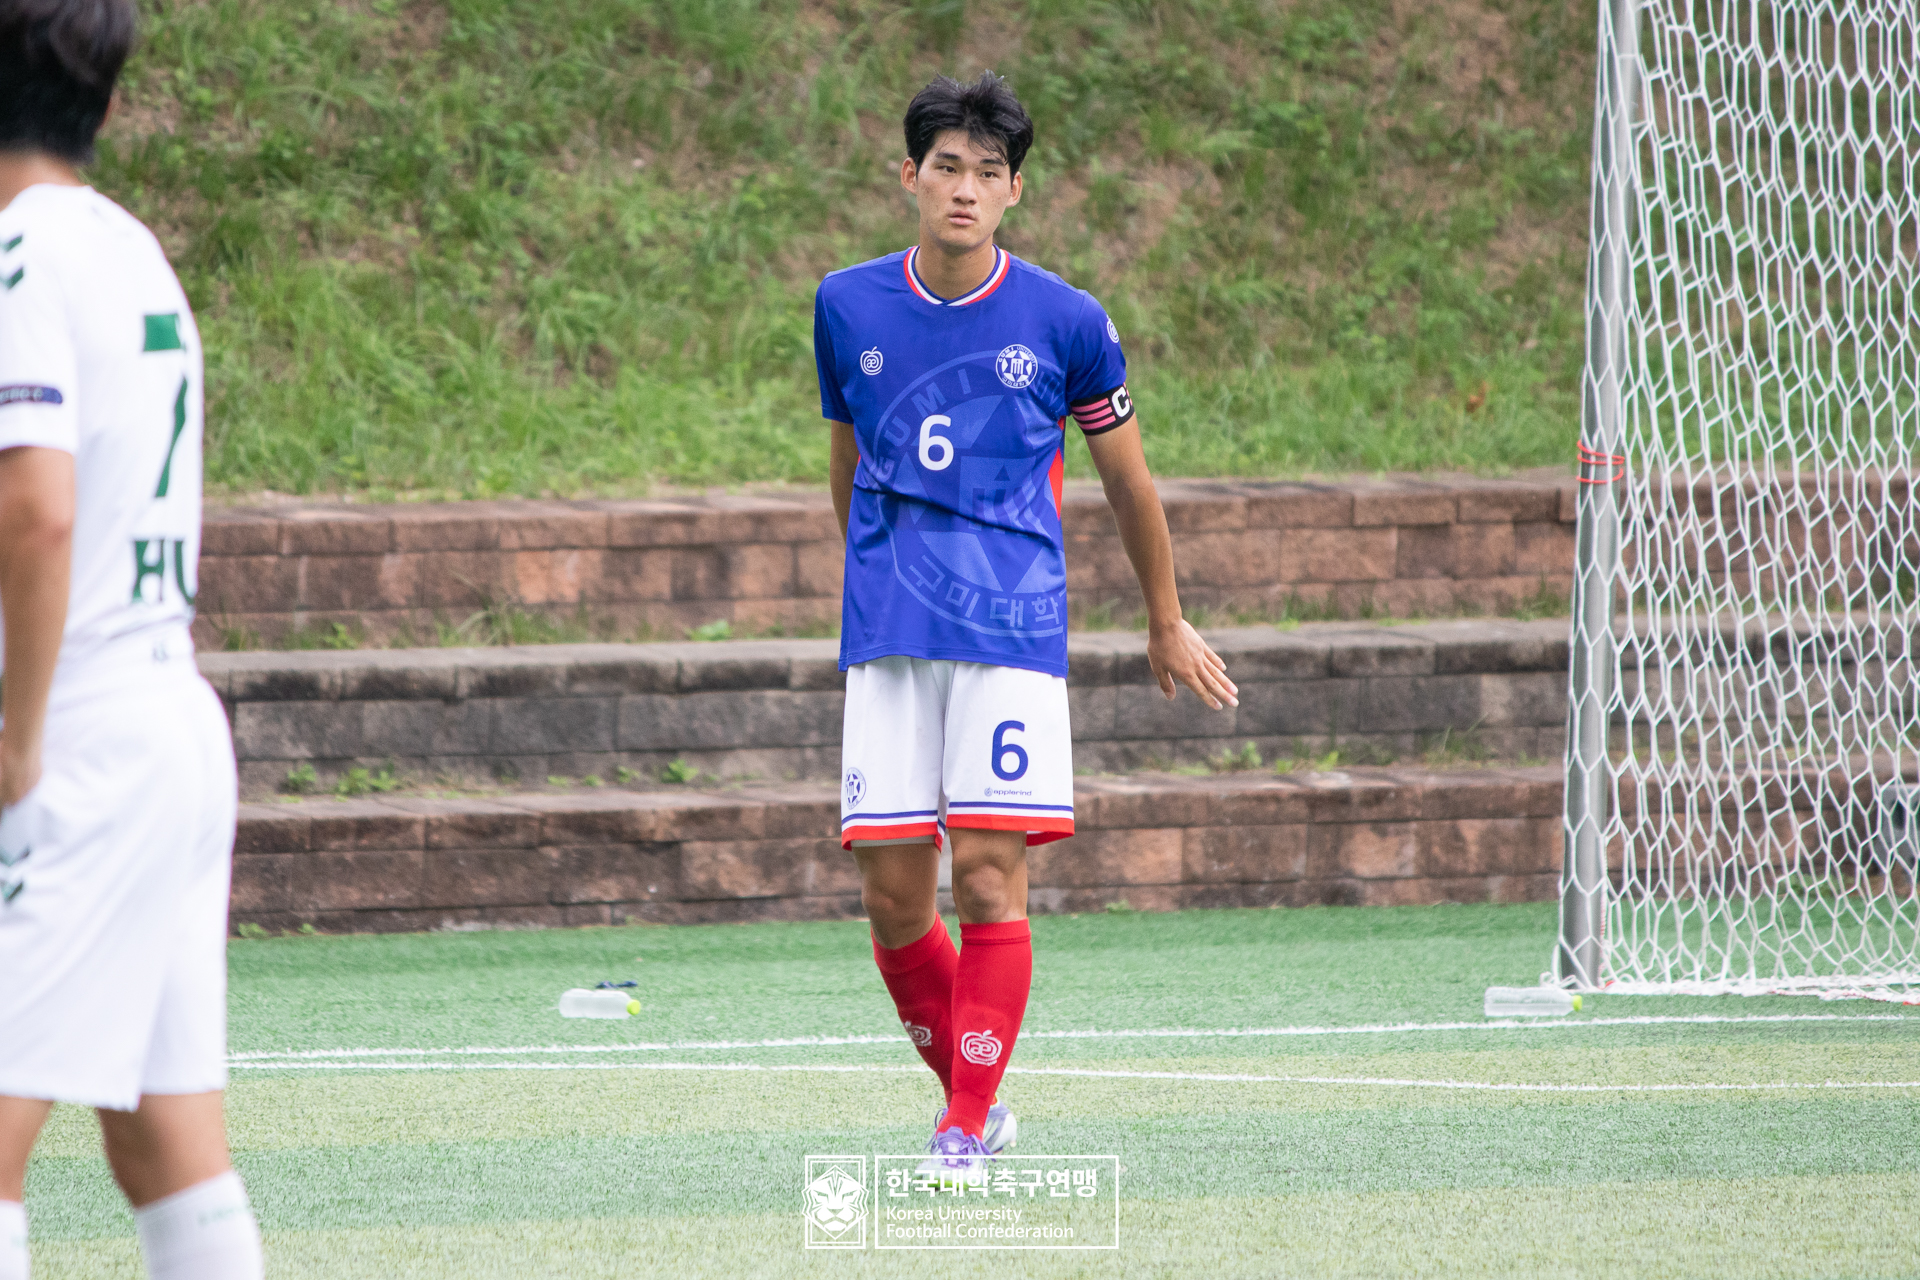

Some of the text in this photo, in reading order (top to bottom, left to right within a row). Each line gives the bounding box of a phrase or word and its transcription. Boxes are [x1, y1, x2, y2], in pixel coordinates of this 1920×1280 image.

[874, 368, 972, 483] GUMI
[1111, 386, 1131, 418] C
[918, 414, 954, 471] 6
[991, 719, 1029, 782] 6
